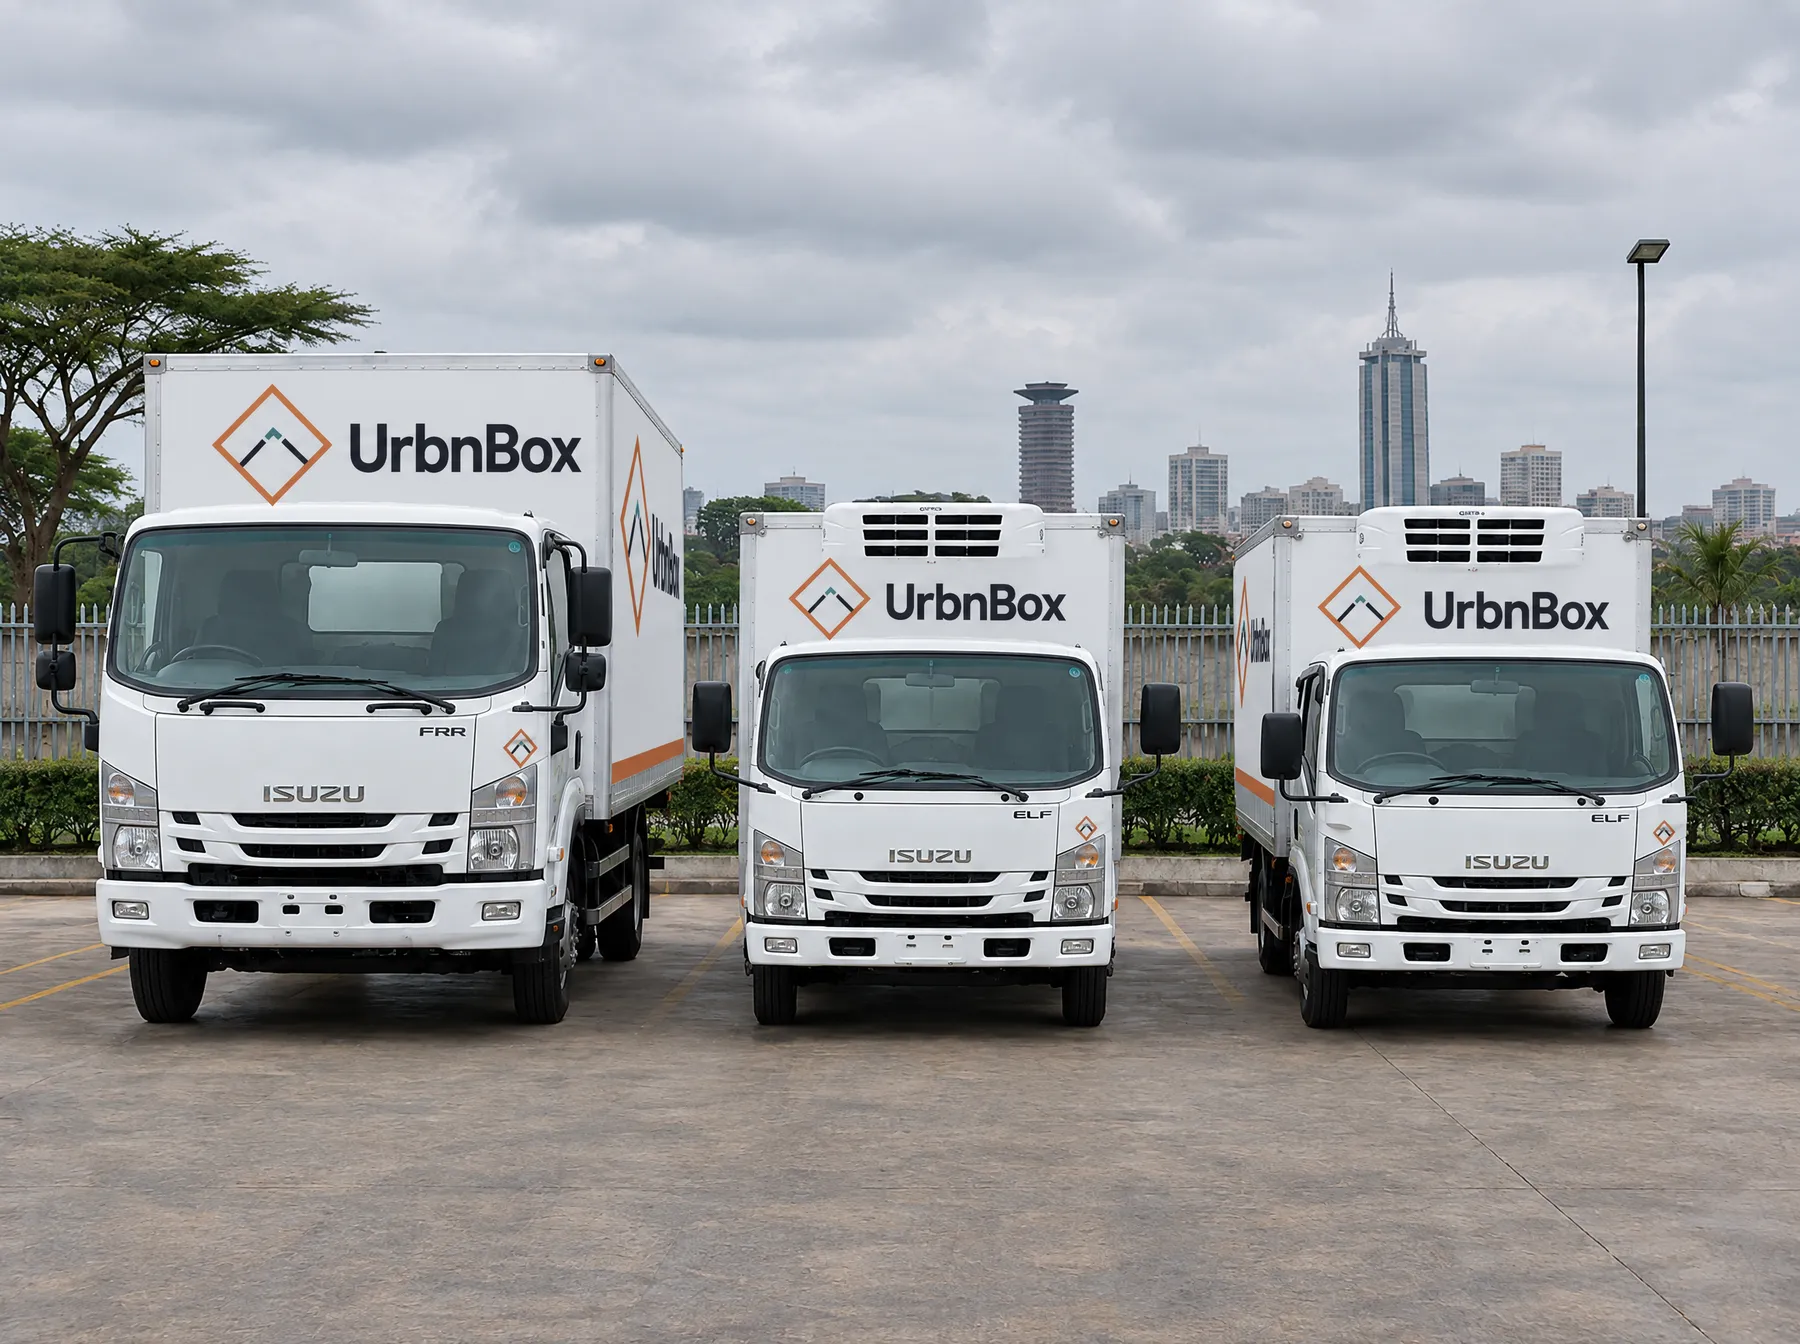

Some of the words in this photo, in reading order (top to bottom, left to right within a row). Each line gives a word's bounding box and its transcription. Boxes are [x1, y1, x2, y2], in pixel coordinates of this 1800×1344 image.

[350, 423, 582, 474] UrbnBox
[886, 582, 1067, 622] UrbnBox
[1424, 590, 1610, 631] UrbnBox
[419, 727, 466, 737] FRR
[263, 785, 365, 804] ISUZU
[1013, 810, 1053, 819] ELF
[1591, 814, 1630, 823] ELF
[888, 849, 972, 864] ISUZU
[1465, 855, 1550, 870] ISUZU
